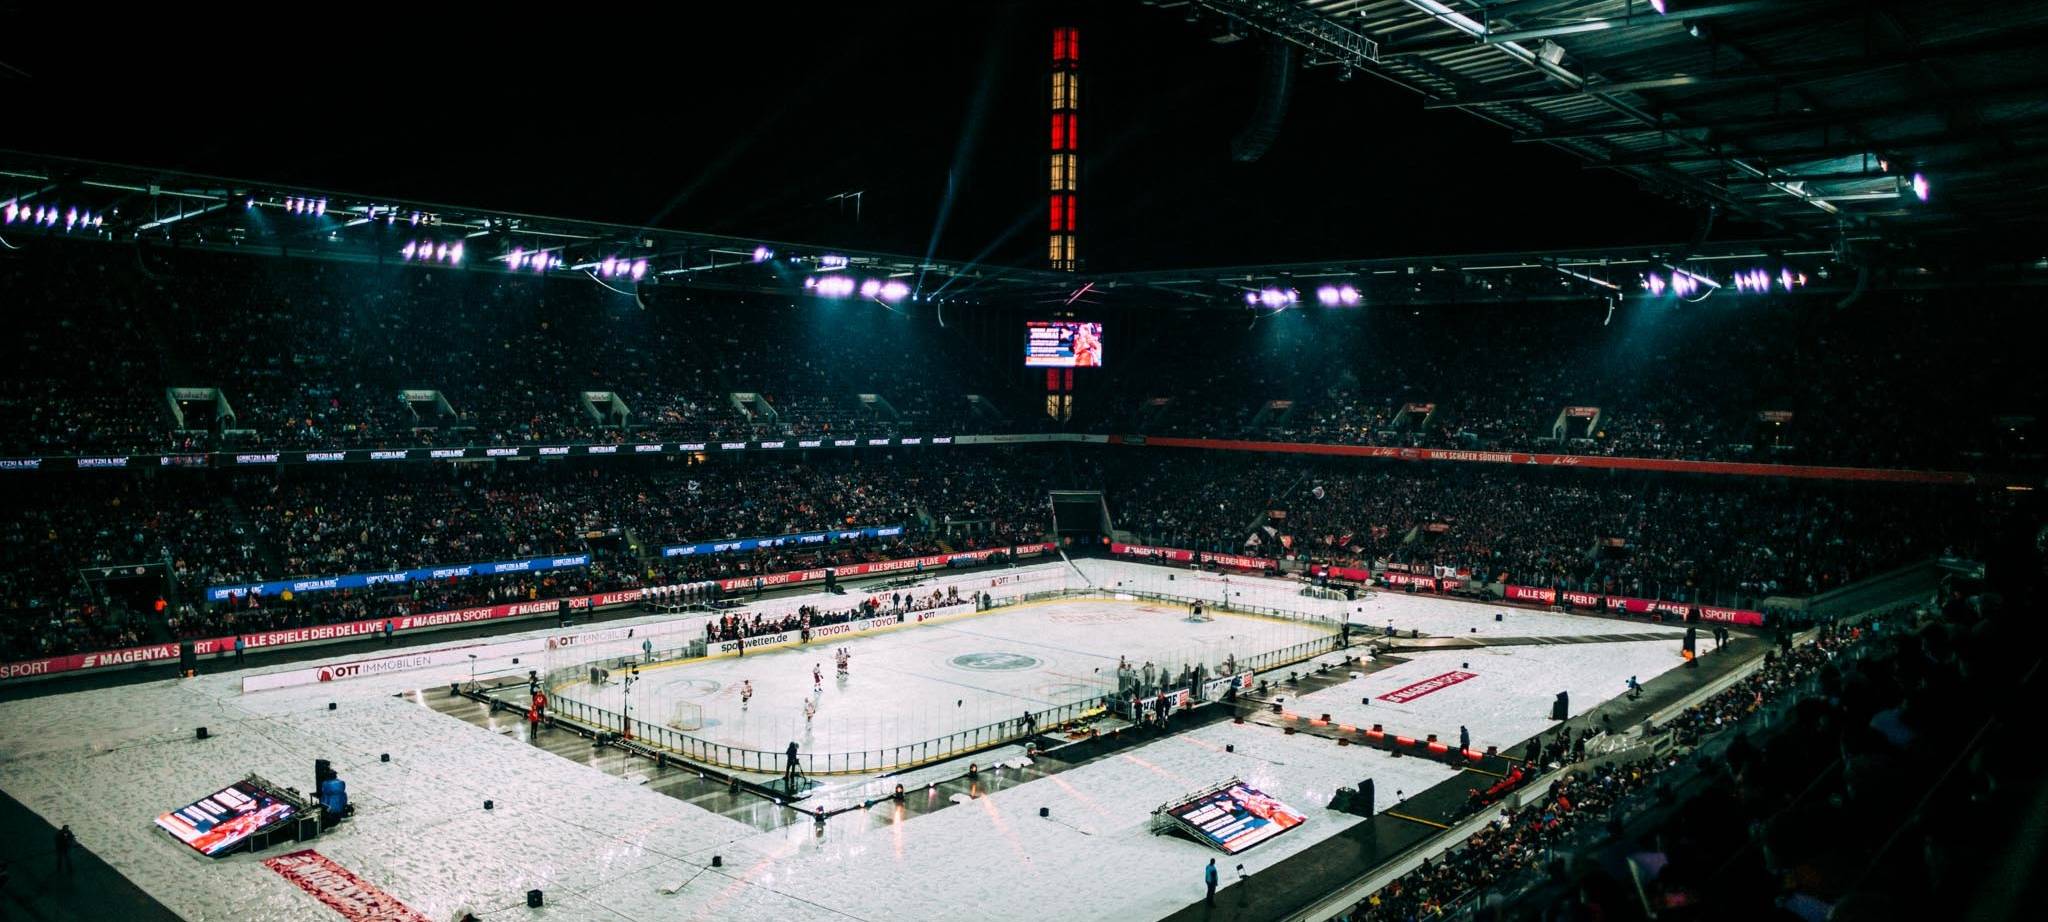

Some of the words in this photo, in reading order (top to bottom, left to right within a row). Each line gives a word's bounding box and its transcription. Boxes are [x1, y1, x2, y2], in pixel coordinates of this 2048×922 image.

[840, 567, 859, 576] SPORT
[768, 575, 790, 584] SPORT
[602, 593, 623, 604] ALLE
[1517, 589, 1538, 599] ALLE
[569, 597, 588, 608] PORT
[413, 612, 461, 627] MAGENTA
[463, 608, 492, 620] SPORT
[1705, 609, 1736, 621] SPORT
[872, 617, 899, 628] TOYOT
[268, 630, 308, 646] SPIELE
[310, 628, 334, 642] DER
[336, 625, 358, 639] DEL
[359, 621, 383, 634] LIVE
[818, 624, 850, 637] TOYOTA
[721, 634, 787, 652] spowetten.de
[100, 647, 169, 666] MAGENTA
[0, 661, 51, 679] SPORT
[335, 664, 361, 678] OTT
[363, 655, 431, 673] IMMOBILIEN
